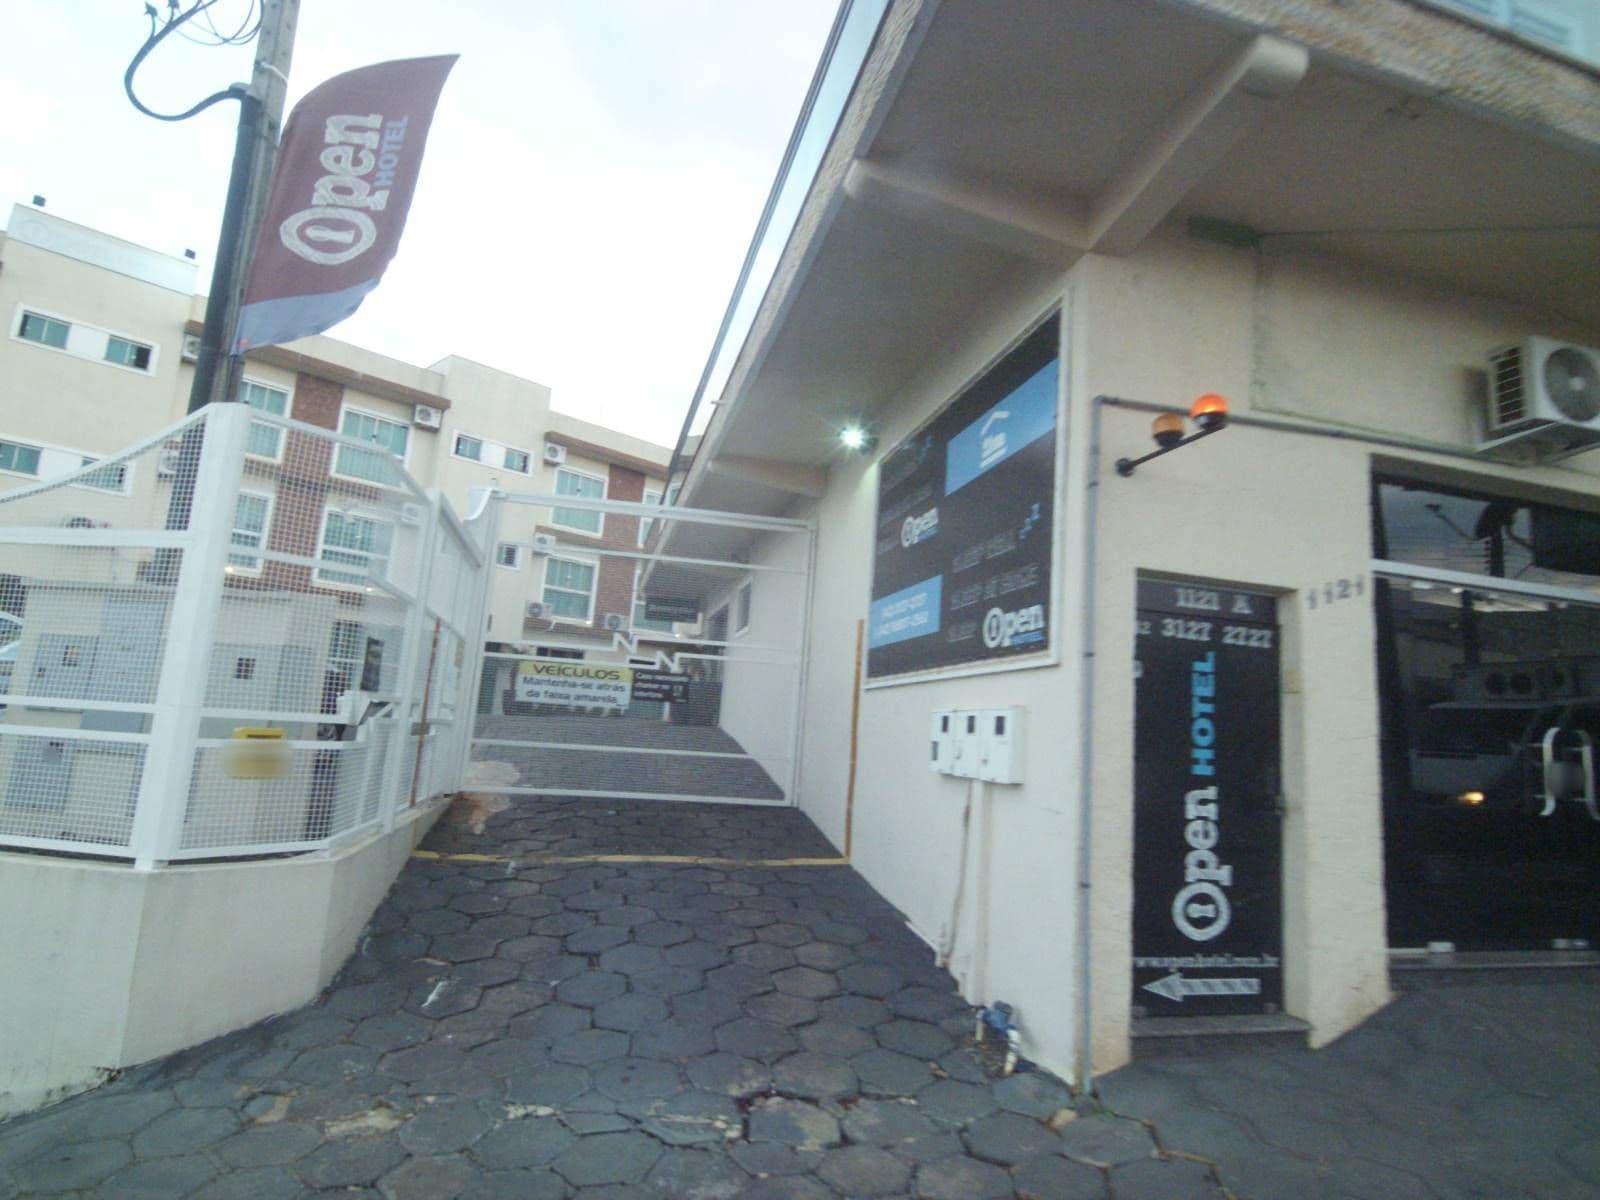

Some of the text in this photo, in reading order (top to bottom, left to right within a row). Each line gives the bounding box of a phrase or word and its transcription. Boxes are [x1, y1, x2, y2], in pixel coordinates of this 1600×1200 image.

[280, 113, 390, 265] Open
[375, 115, 409, 187] HOTEL
[983, 604, 1044, 648] Open
[1172, 651, 1233, 941] Open HOTEL
